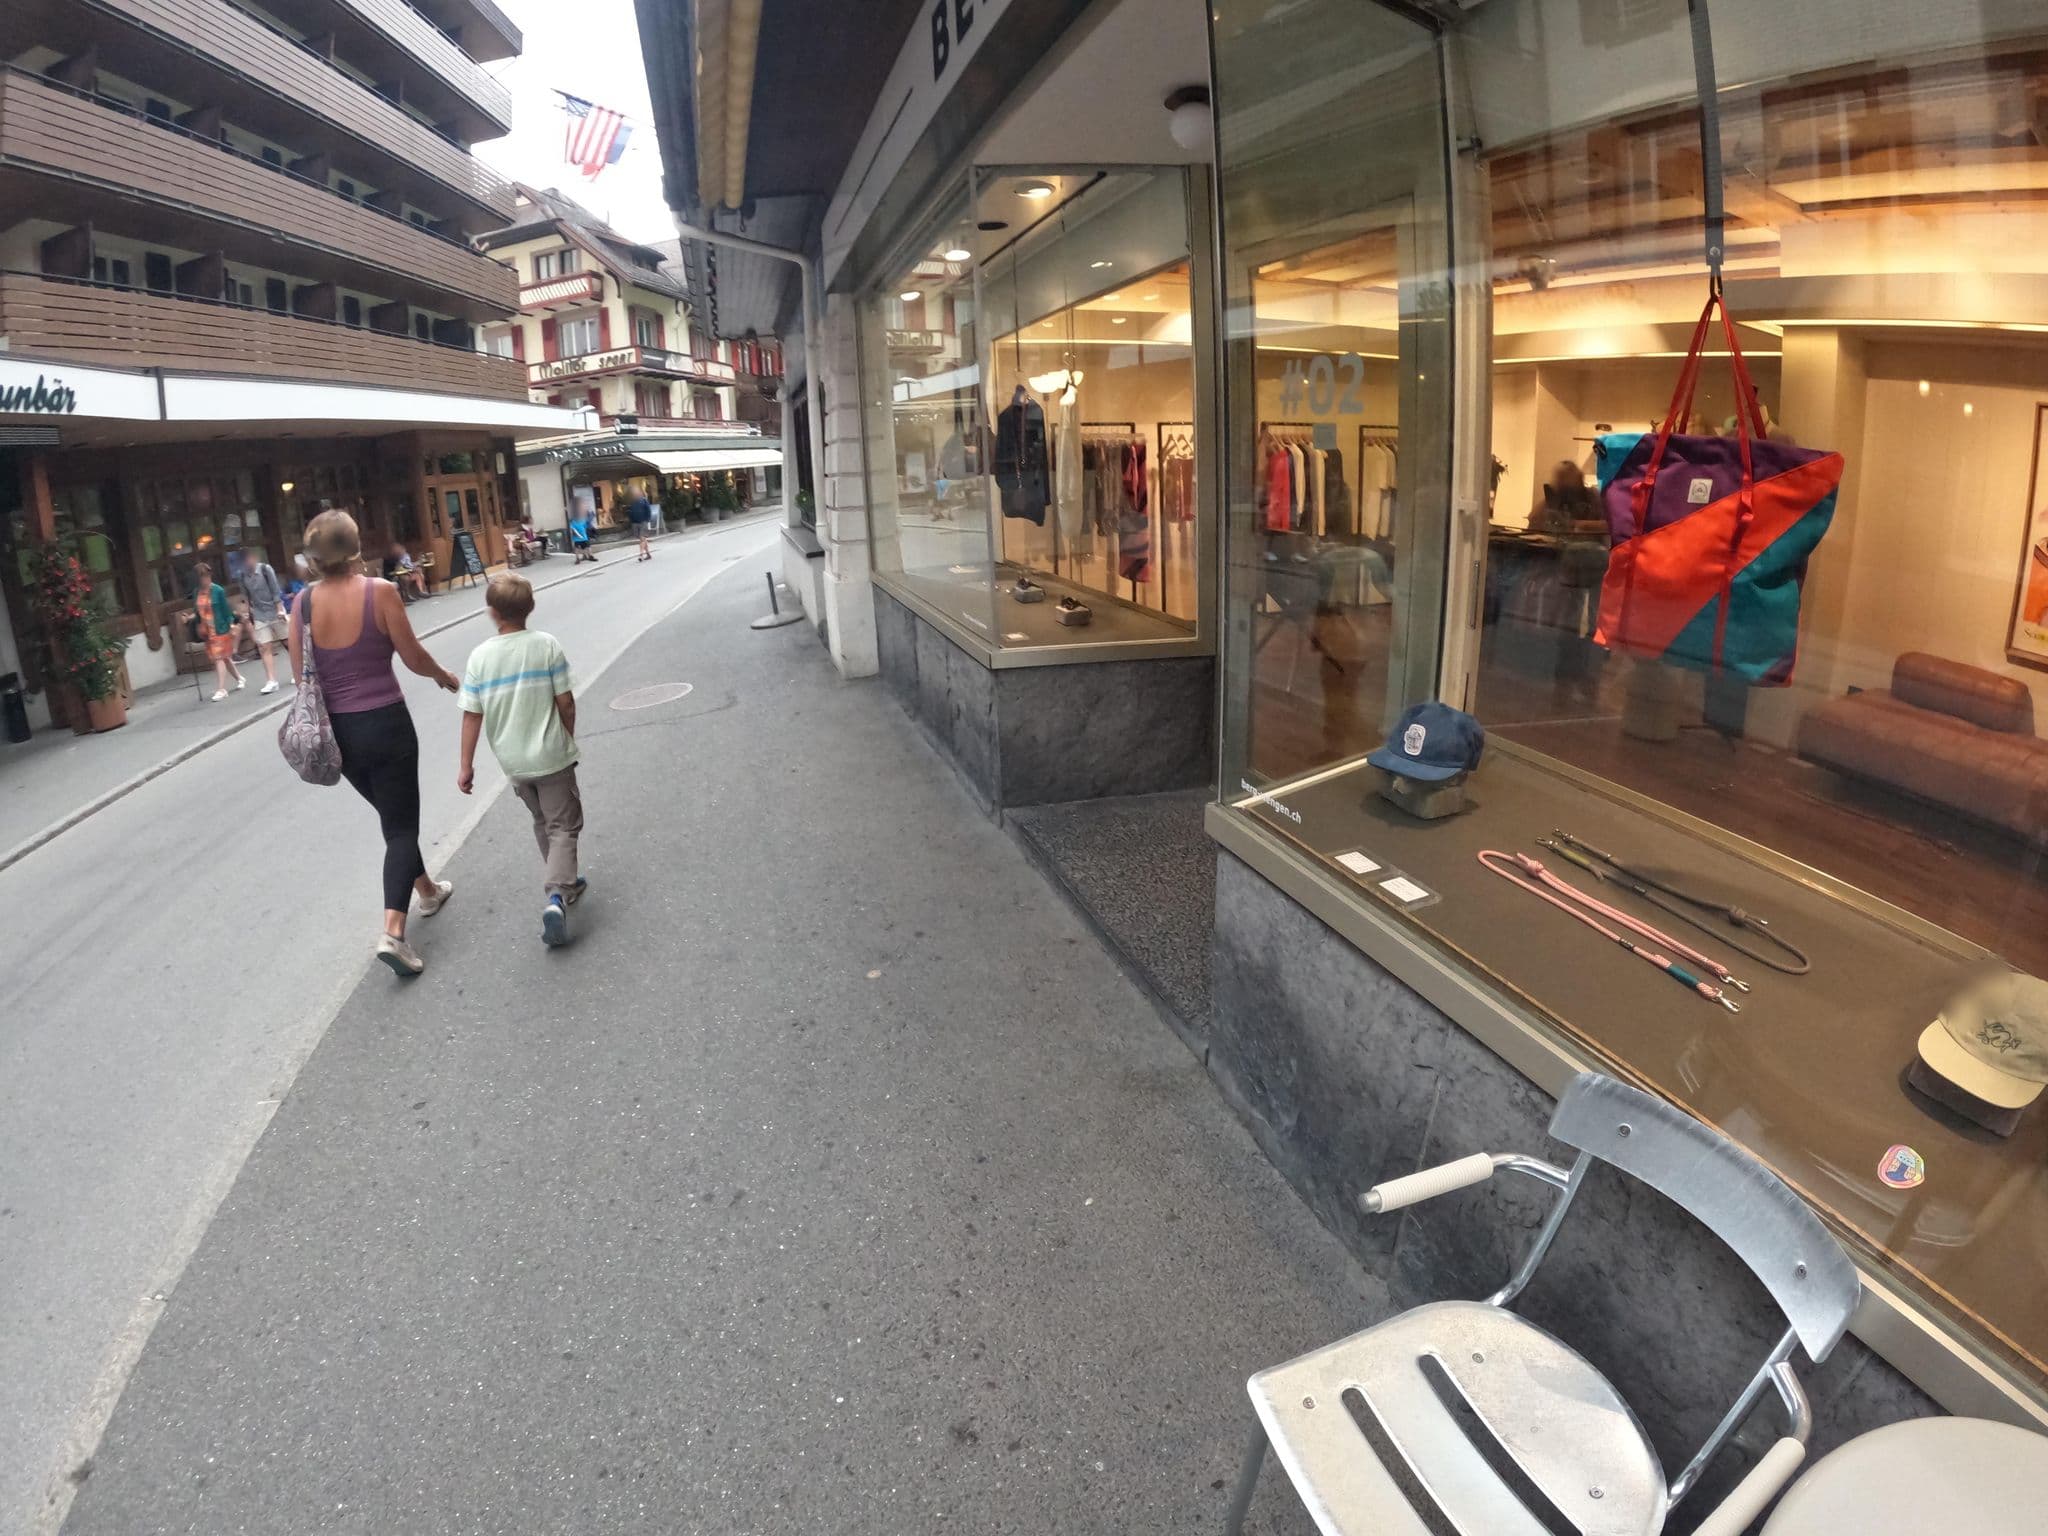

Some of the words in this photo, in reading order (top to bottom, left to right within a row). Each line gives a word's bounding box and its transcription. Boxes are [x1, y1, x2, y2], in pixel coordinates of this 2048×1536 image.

[932, 0, 990, 83] BE
[598, 352, 634, 369] SPORT
[1280, 352, 1365, 416] #02
